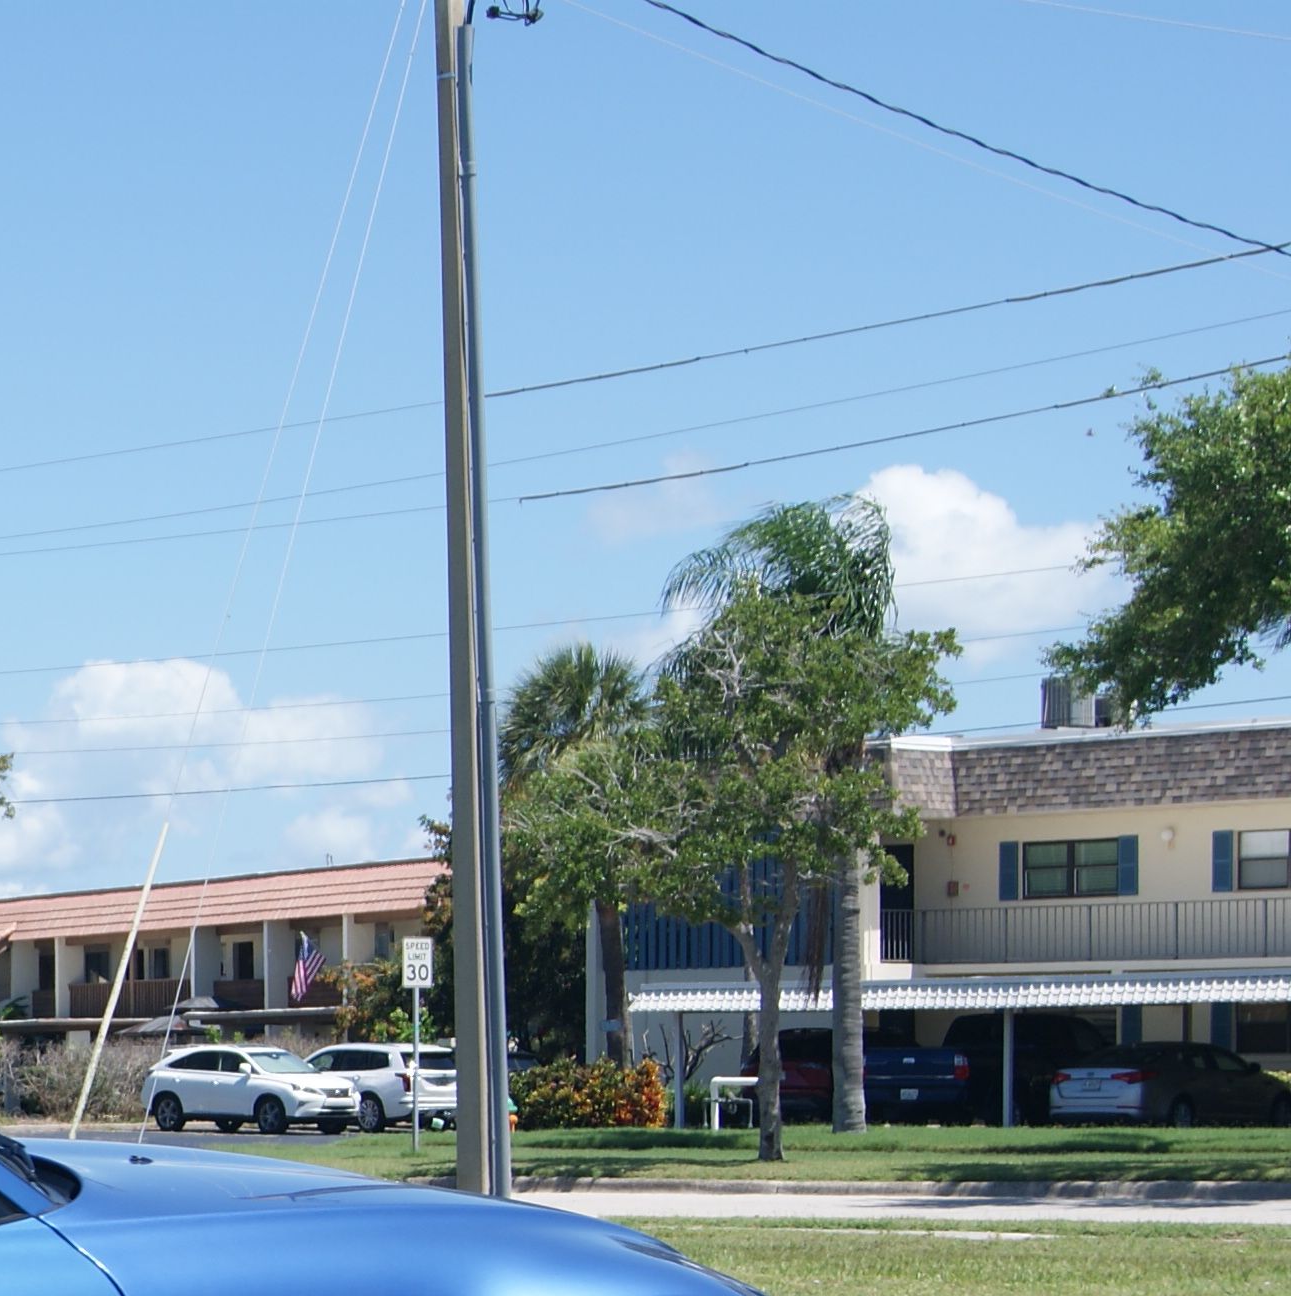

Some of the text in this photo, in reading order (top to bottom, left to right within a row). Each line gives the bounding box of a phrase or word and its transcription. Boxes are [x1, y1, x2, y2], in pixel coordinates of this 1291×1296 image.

[405, 942, 430, 951] SPEED
[407, 953, 427, 961] LIMIT
[406, 963, 429, 982] 30
